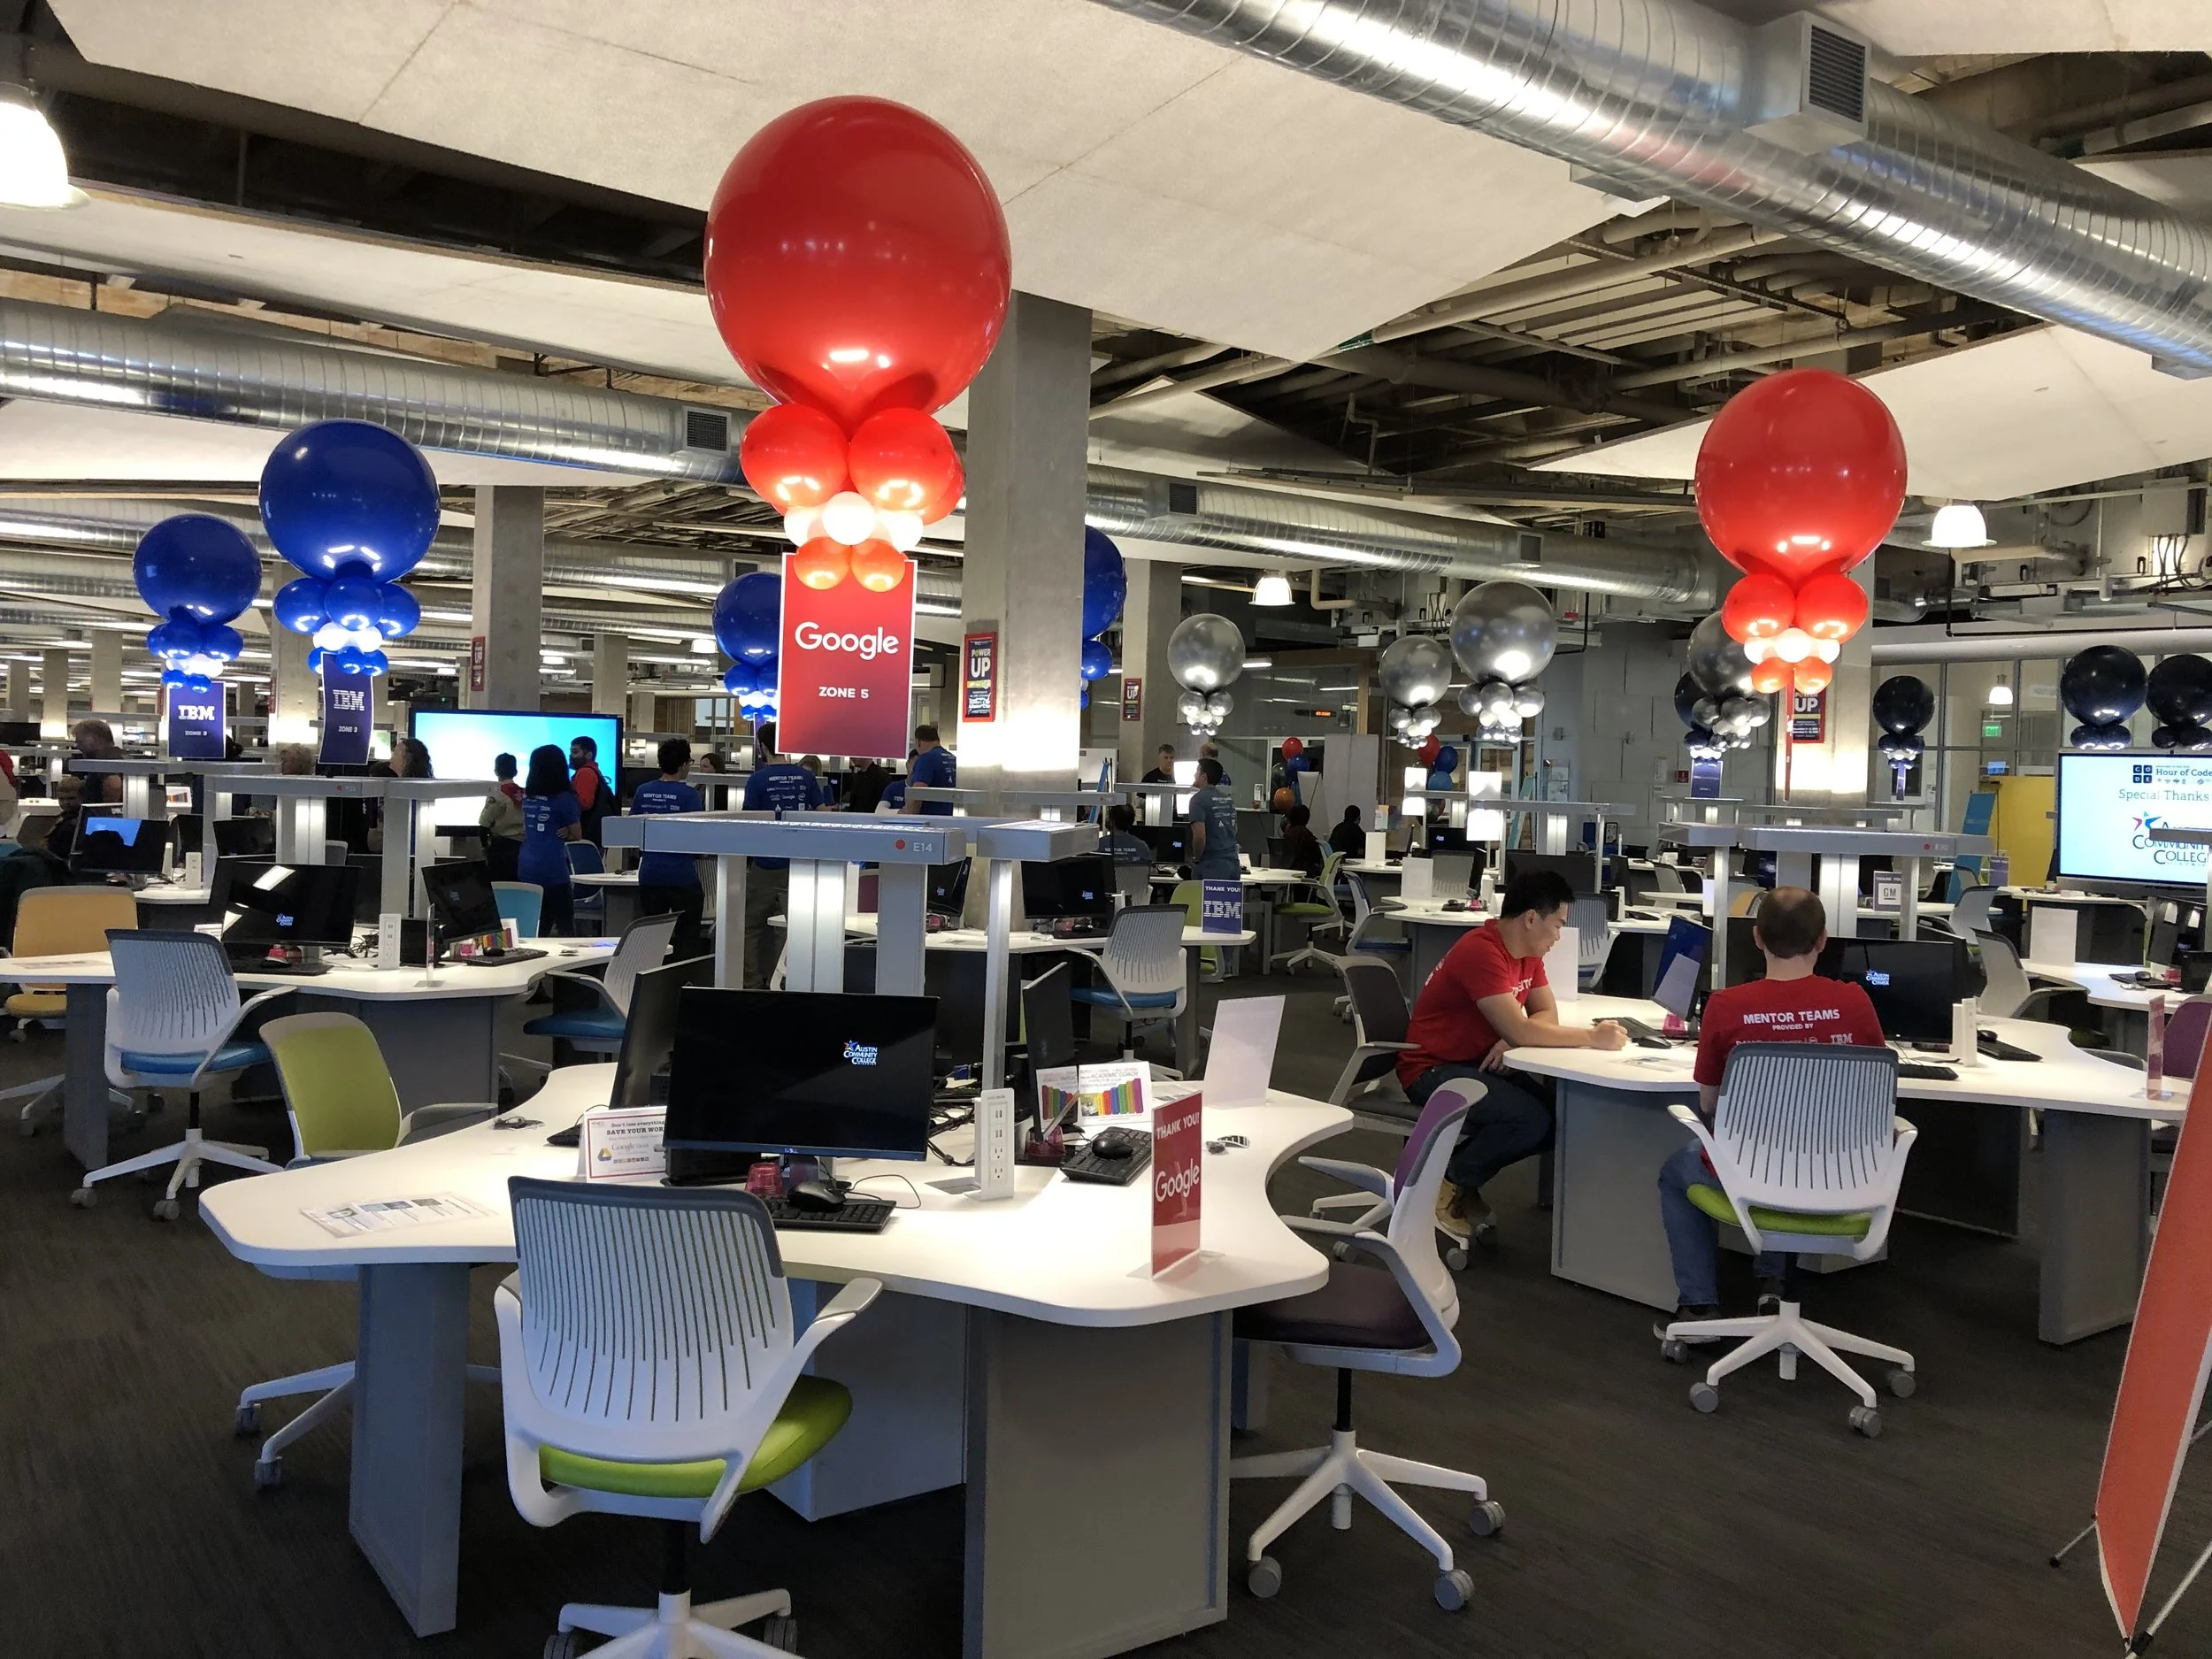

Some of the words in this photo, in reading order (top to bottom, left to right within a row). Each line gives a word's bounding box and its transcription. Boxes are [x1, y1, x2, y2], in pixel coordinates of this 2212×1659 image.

[795, 621, 900, 660] Google
[972, 649, 991, 657] POWER
[971, 657, 991, 678] UP
[332, 689, 365, 711] IBM
[818, 686, 856, 698] ZONE
[860, 688, 870, 699] 5
[1126, 689, 1139, 700] UP
[1794, 697, 1818, 712] UP
[178, 705, 215, 720] IBM
[2119, 789, 2160, 801] Special
[2163, 790, 2209, 801] Thanks
[913, 842, 933, 852] E14
[2154, 849, 2209, 864] COLLEG
[1883, 887, 1896, 897] GM
[1203, 900, 1241, 919] IBM
[1743, 1012, 1795, 1025] MENTOR
[1798, 1010, 1840, 1022] TEAMS
[1830, 1033, 1853, 1044] IBM
[1156, 1118, 1181, 1140] THANK
[1183, 1112, 1200, 1129] YOU!
[1155, 1158, 1200, 1202] Google
